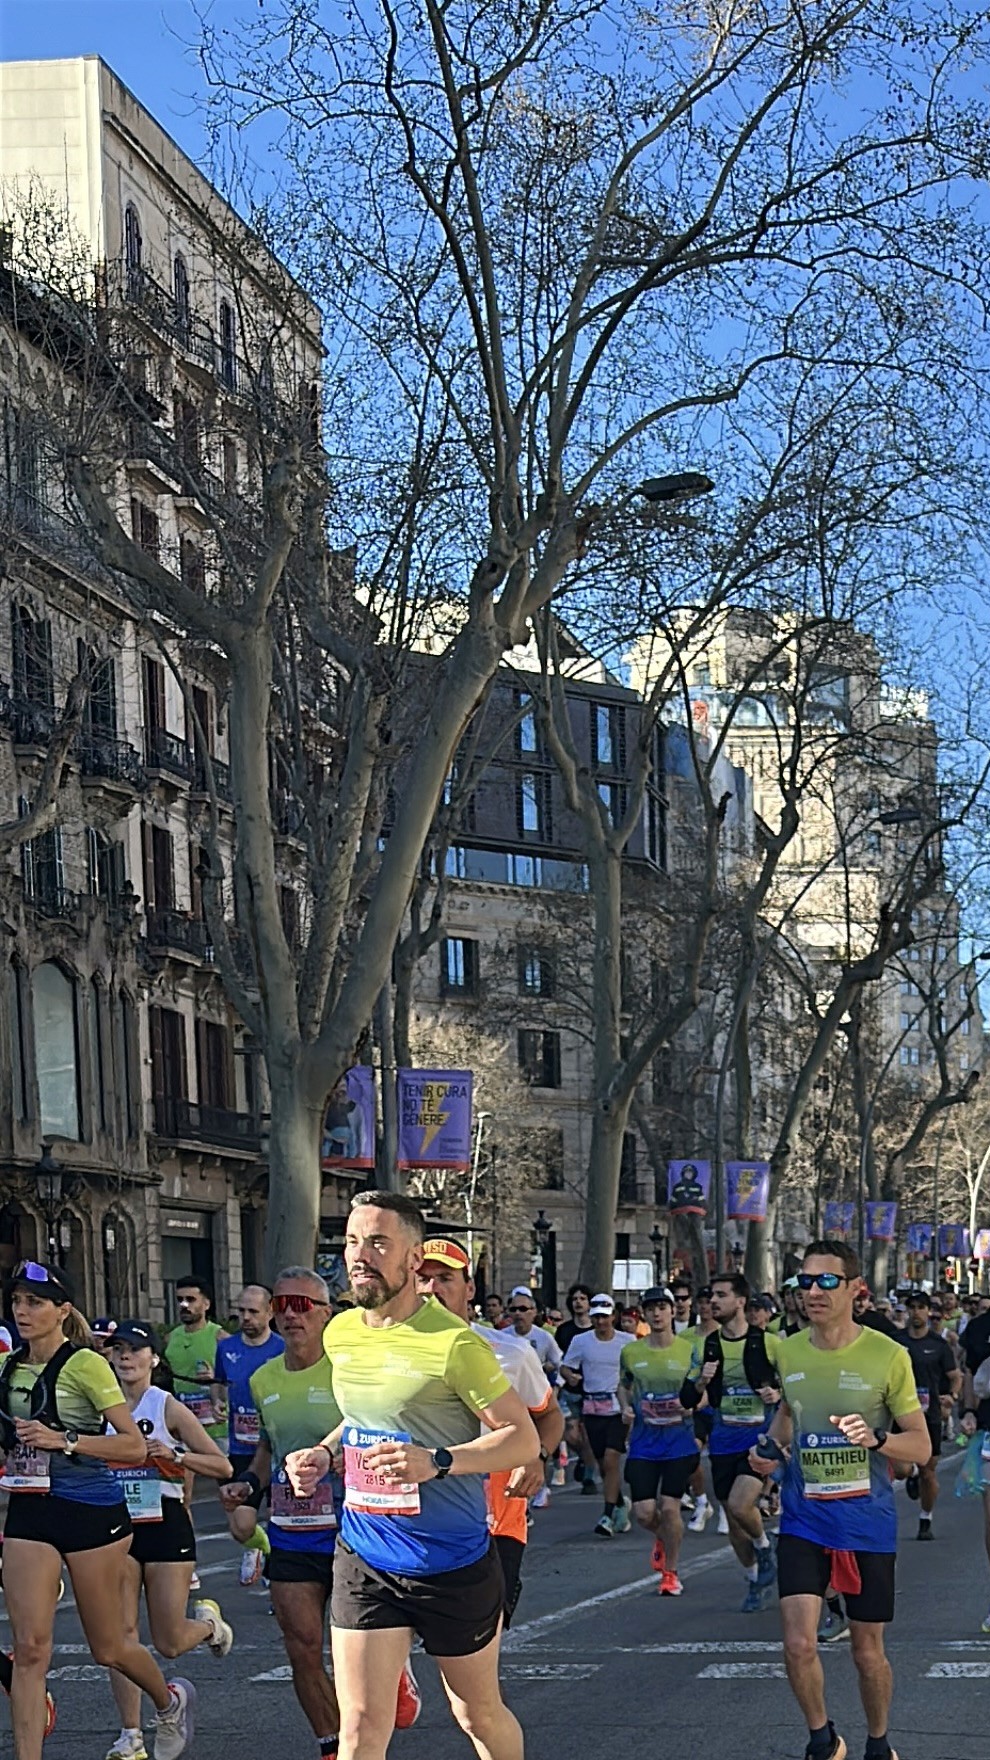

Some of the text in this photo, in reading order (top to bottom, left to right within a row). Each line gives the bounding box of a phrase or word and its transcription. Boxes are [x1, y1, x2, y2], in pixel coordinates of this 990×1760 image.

[402, 1083, 467, 1098] TENIR CURA
[402, 1099, 417, 1112] NO
[359, 1433, 395, 1444] ZURICH
[821, 1435, 850, 1444] ZURIC
[802, 1450, 866, 1466] MATTHIEU
[116, 1470, 147, 1478] ZURICH
[125, 1483, 141, 1495] LE
